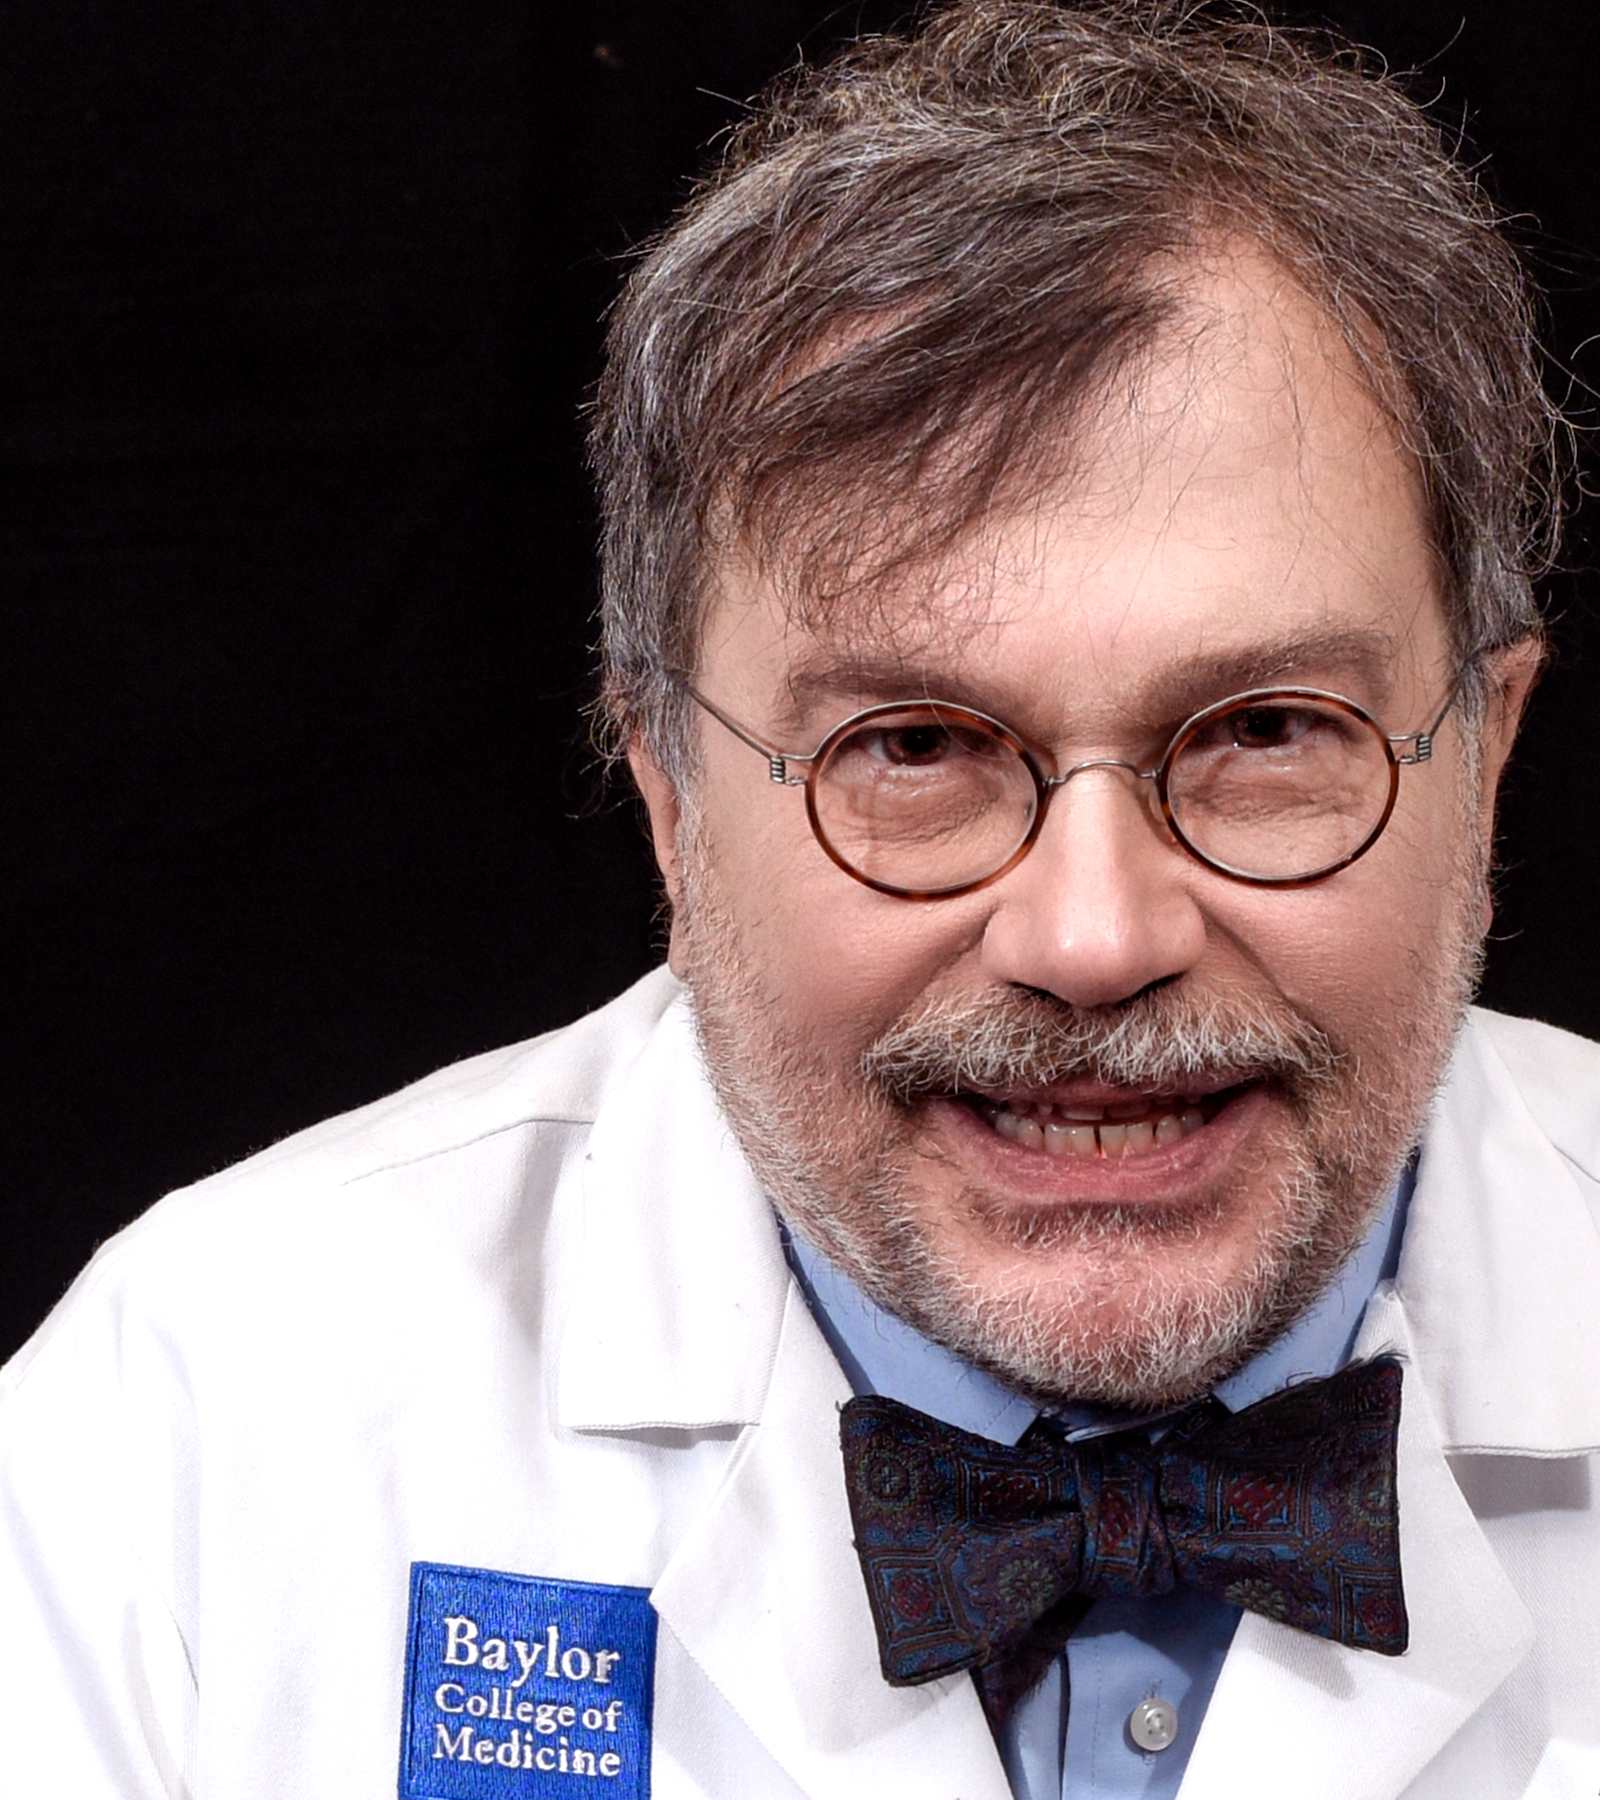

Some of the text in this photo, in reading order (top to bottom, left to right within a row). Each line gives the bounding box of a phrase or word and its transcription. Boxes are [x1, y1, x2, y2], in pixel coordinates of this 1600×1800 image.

[442, 1614, 621, 1686] Baylor
[433, 1682, 623, 1734] College of
[431, 1722, 623, 1778] Medicine
